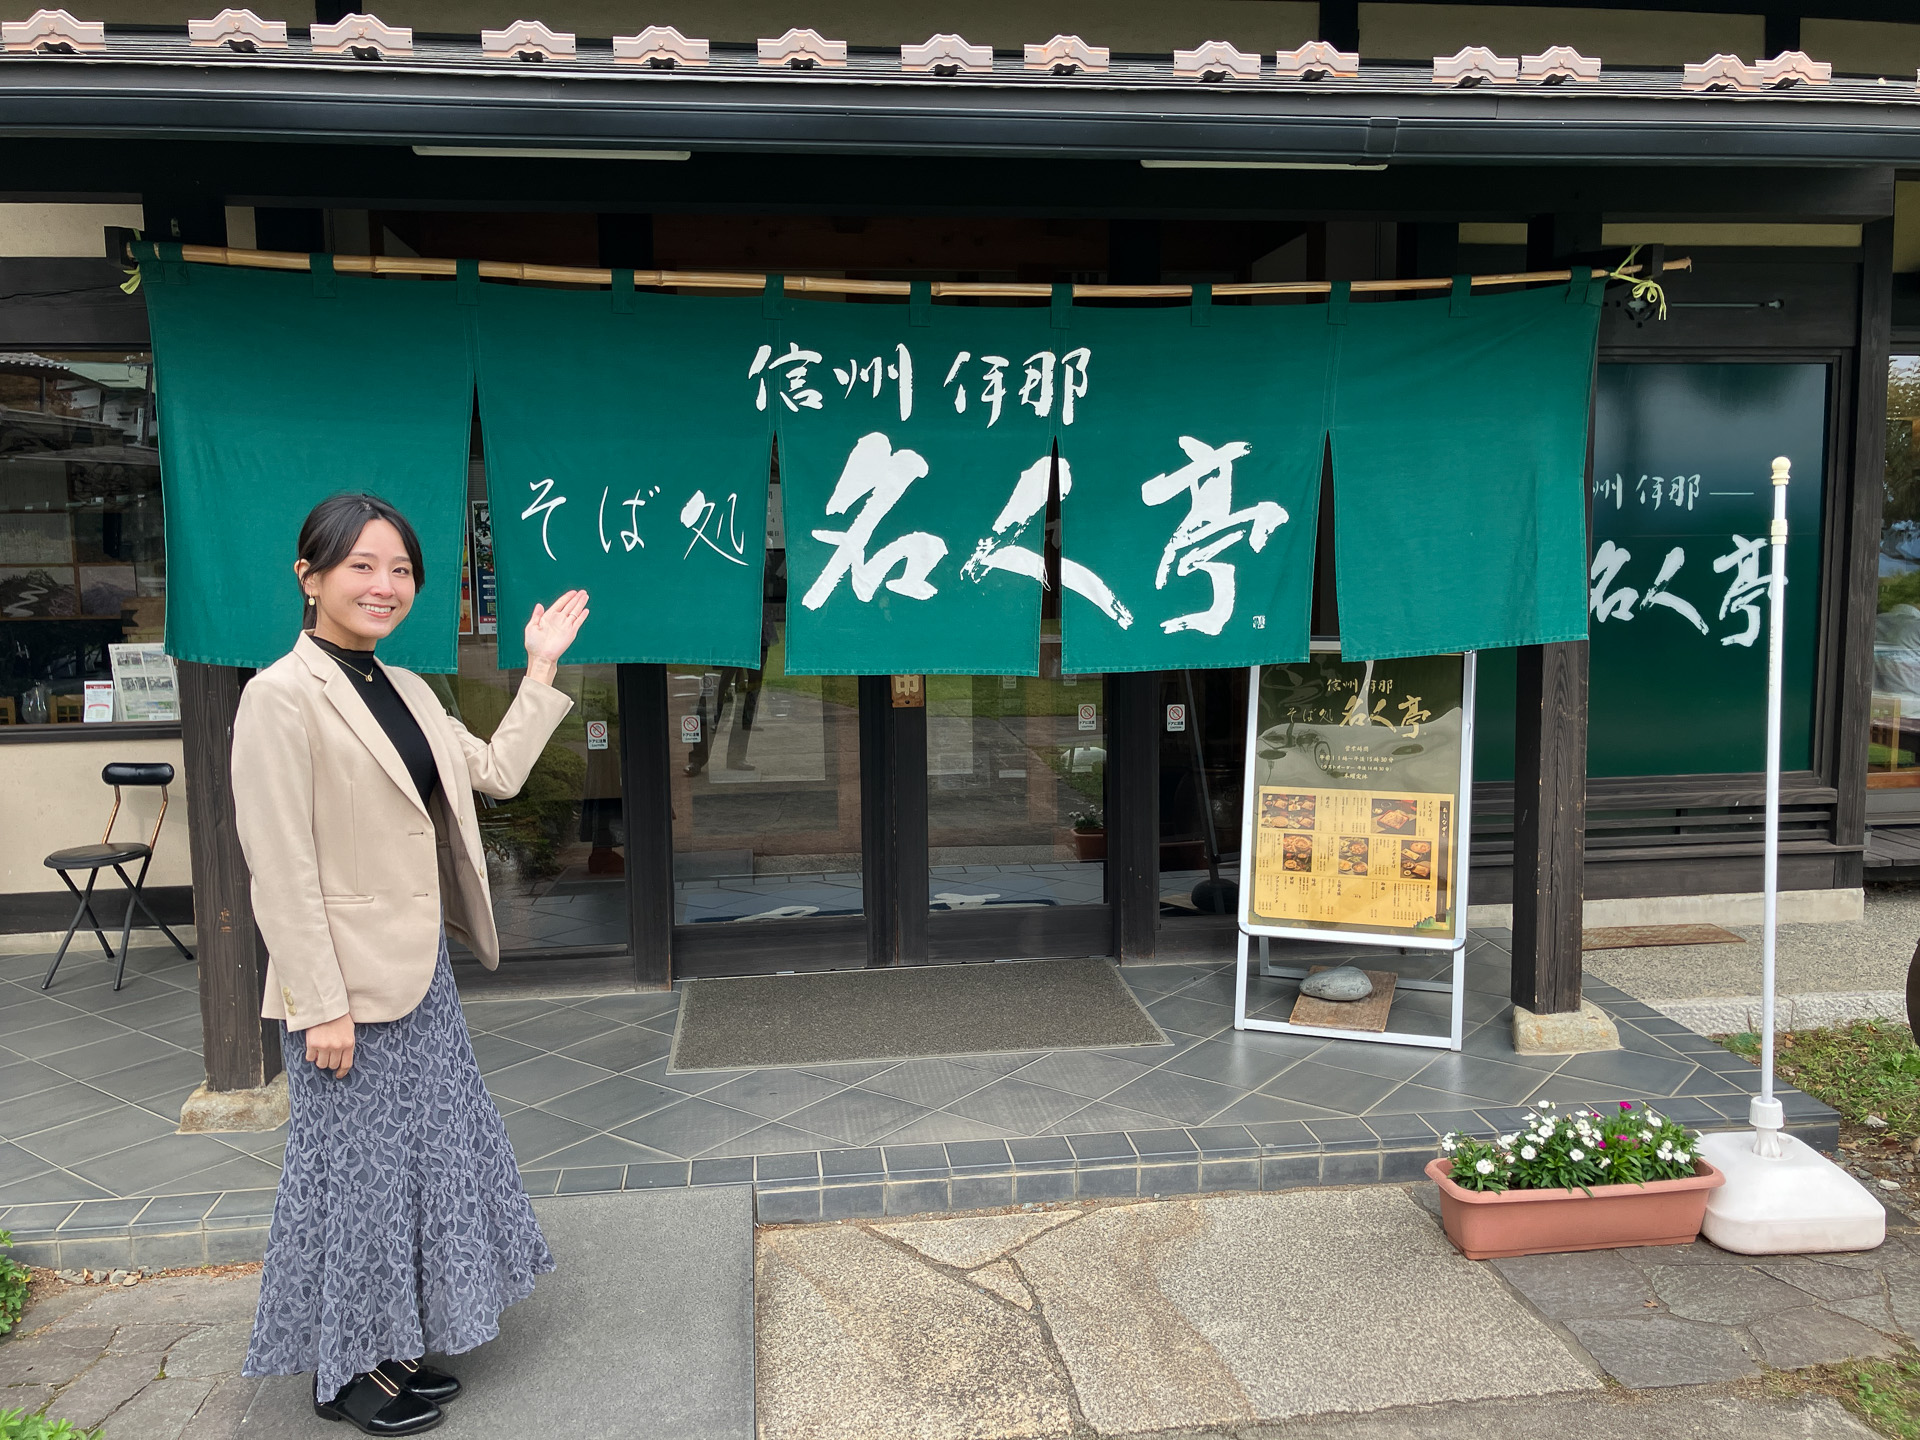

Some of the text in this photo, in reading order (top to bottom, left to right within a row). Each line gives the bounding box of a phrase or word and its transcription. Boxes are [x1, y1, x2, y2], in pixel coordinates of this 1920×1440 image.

[748, 342, 1092, 429] 信州 伊那
[1635, 473, 1701, 511] 伊那
[521, 431, 1290, 636] そば処 名人亭
[1590, 534, 1789, 647] 名人亭
[1286, 694, 1432, 739] そば処 名人亭
[1327, 679, 1358, 693] 信州
